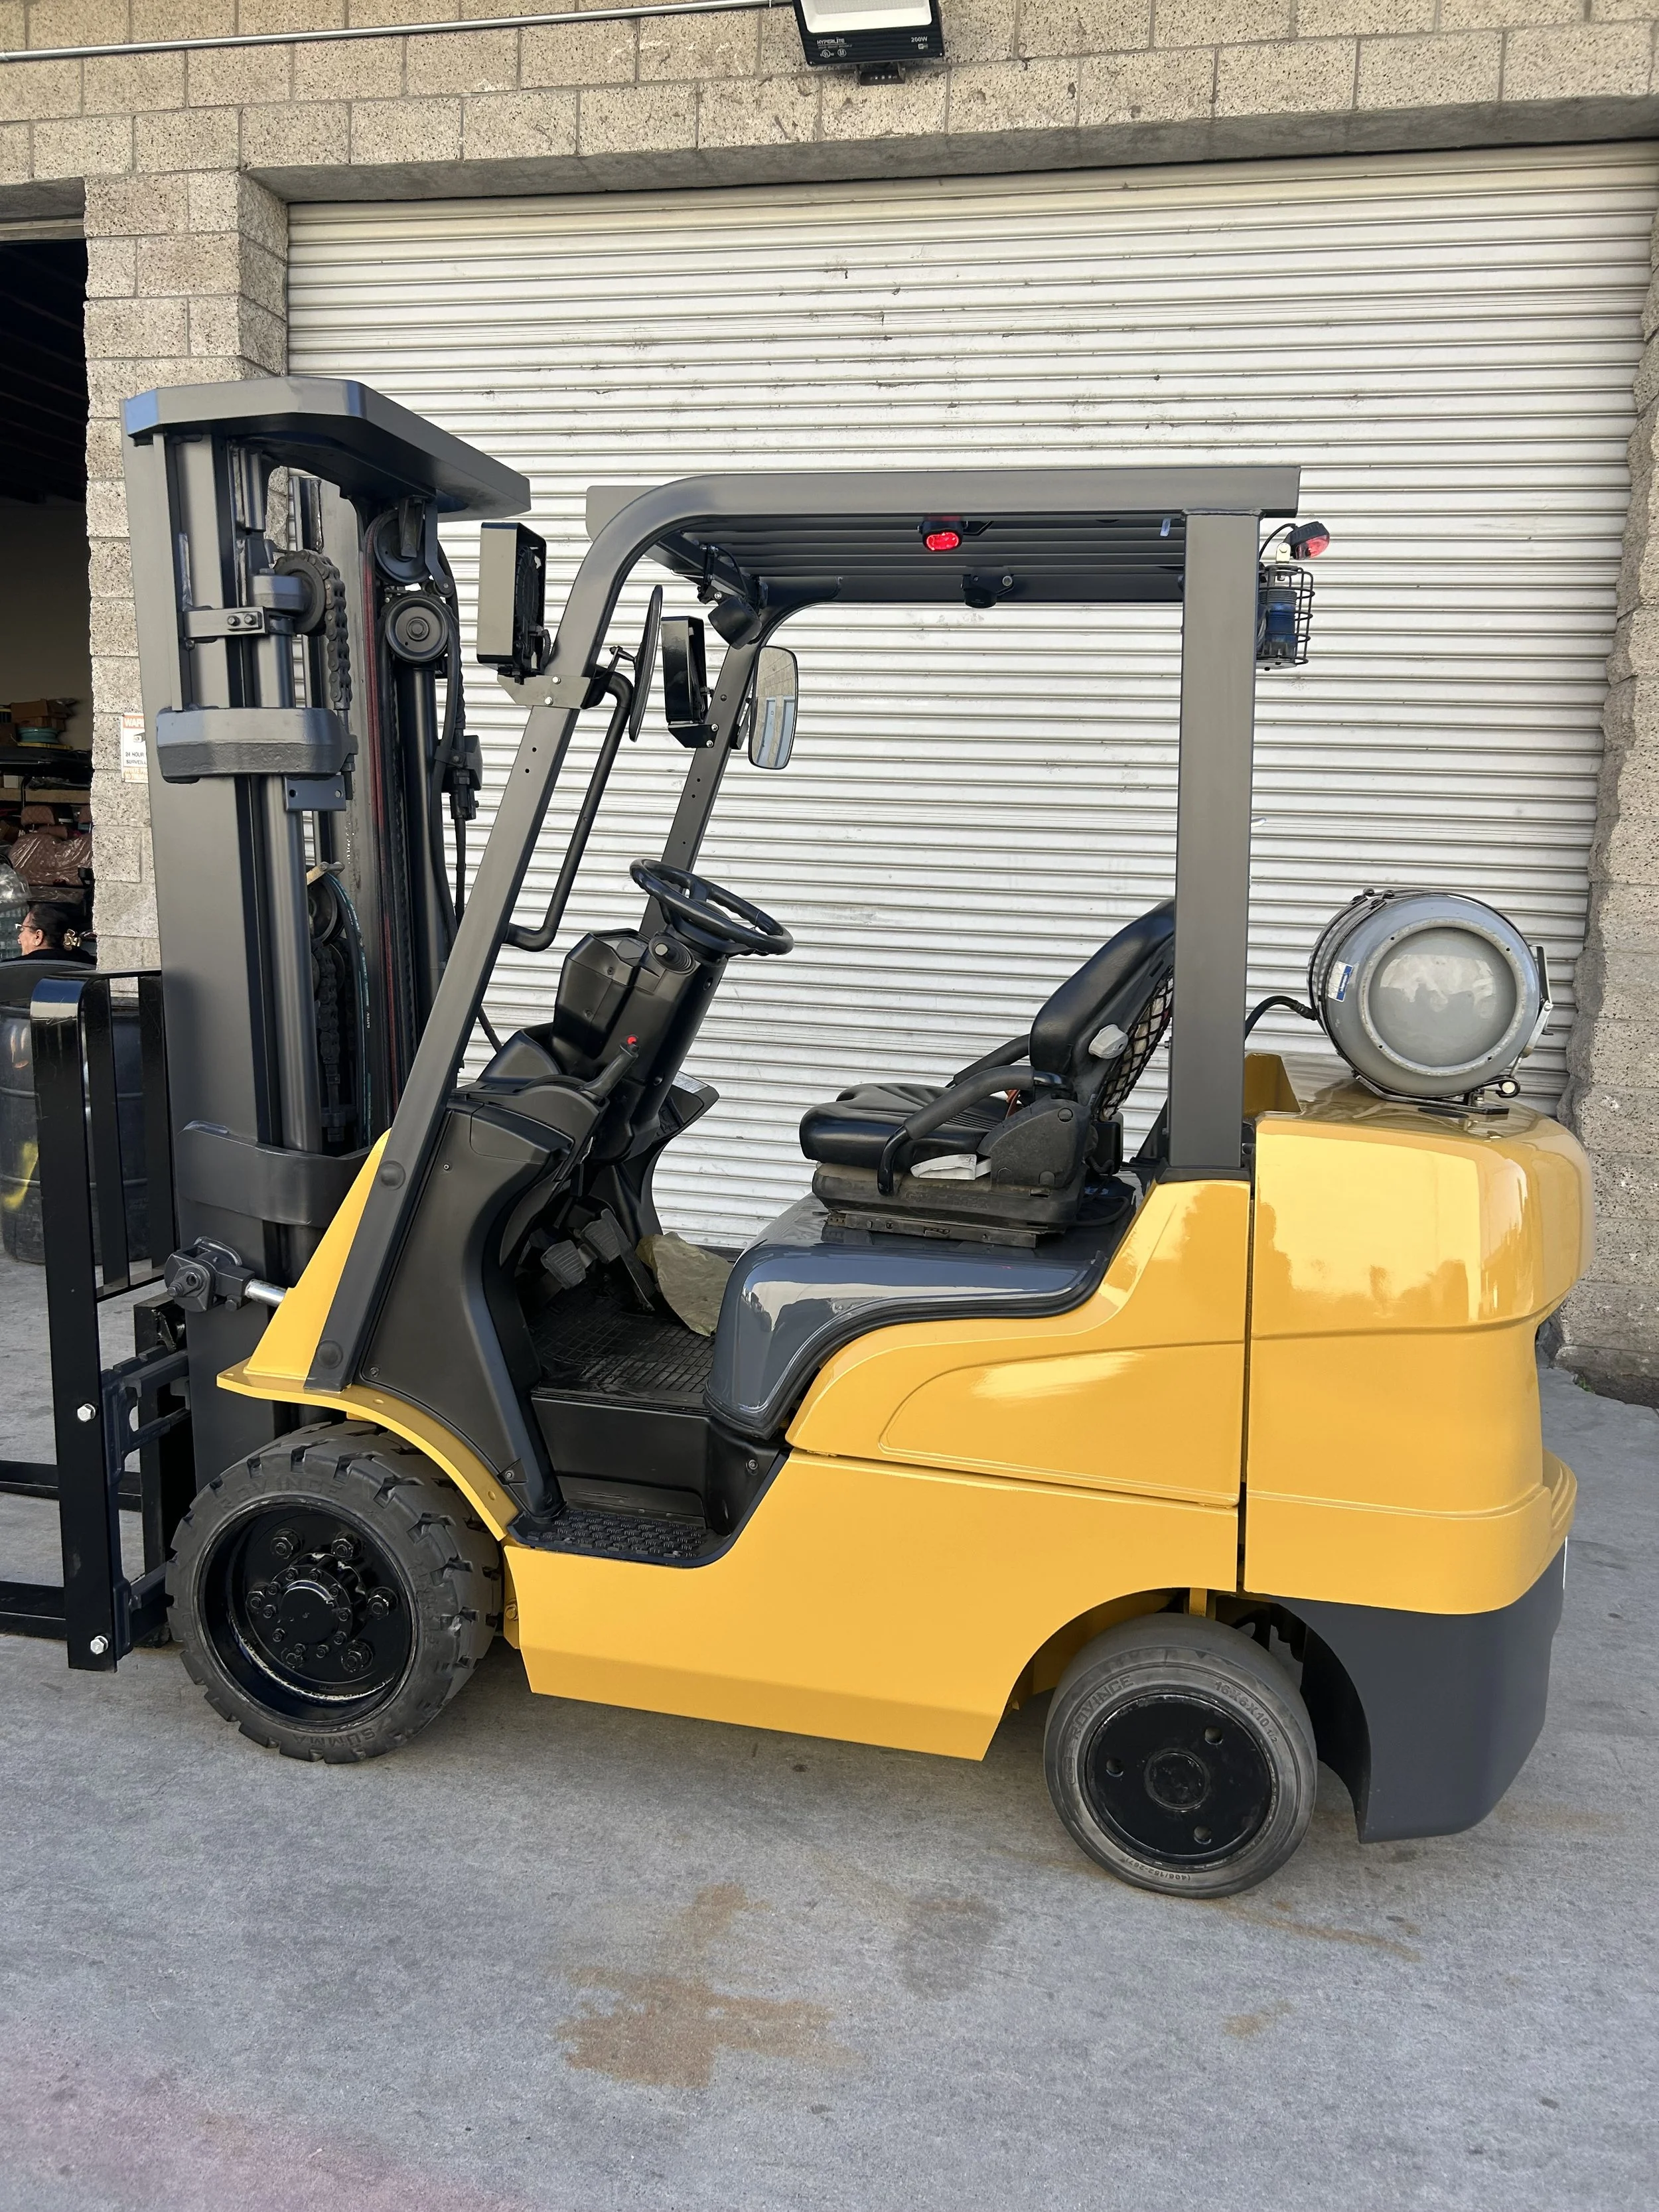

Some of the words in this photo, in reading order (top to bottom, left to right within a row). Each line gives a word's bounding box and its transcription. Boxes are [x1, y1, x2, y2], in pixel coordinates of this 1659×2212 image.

[124, 718, 145, 727] WAR
[1072, 1674, 1134, 1740] ROVINCE
[1215, 1681, 1270, 1727] 16X6X10
[1266, 1729, 1278, 1743] 1/2
[292, 1727, 376, 1747] SUMMA
